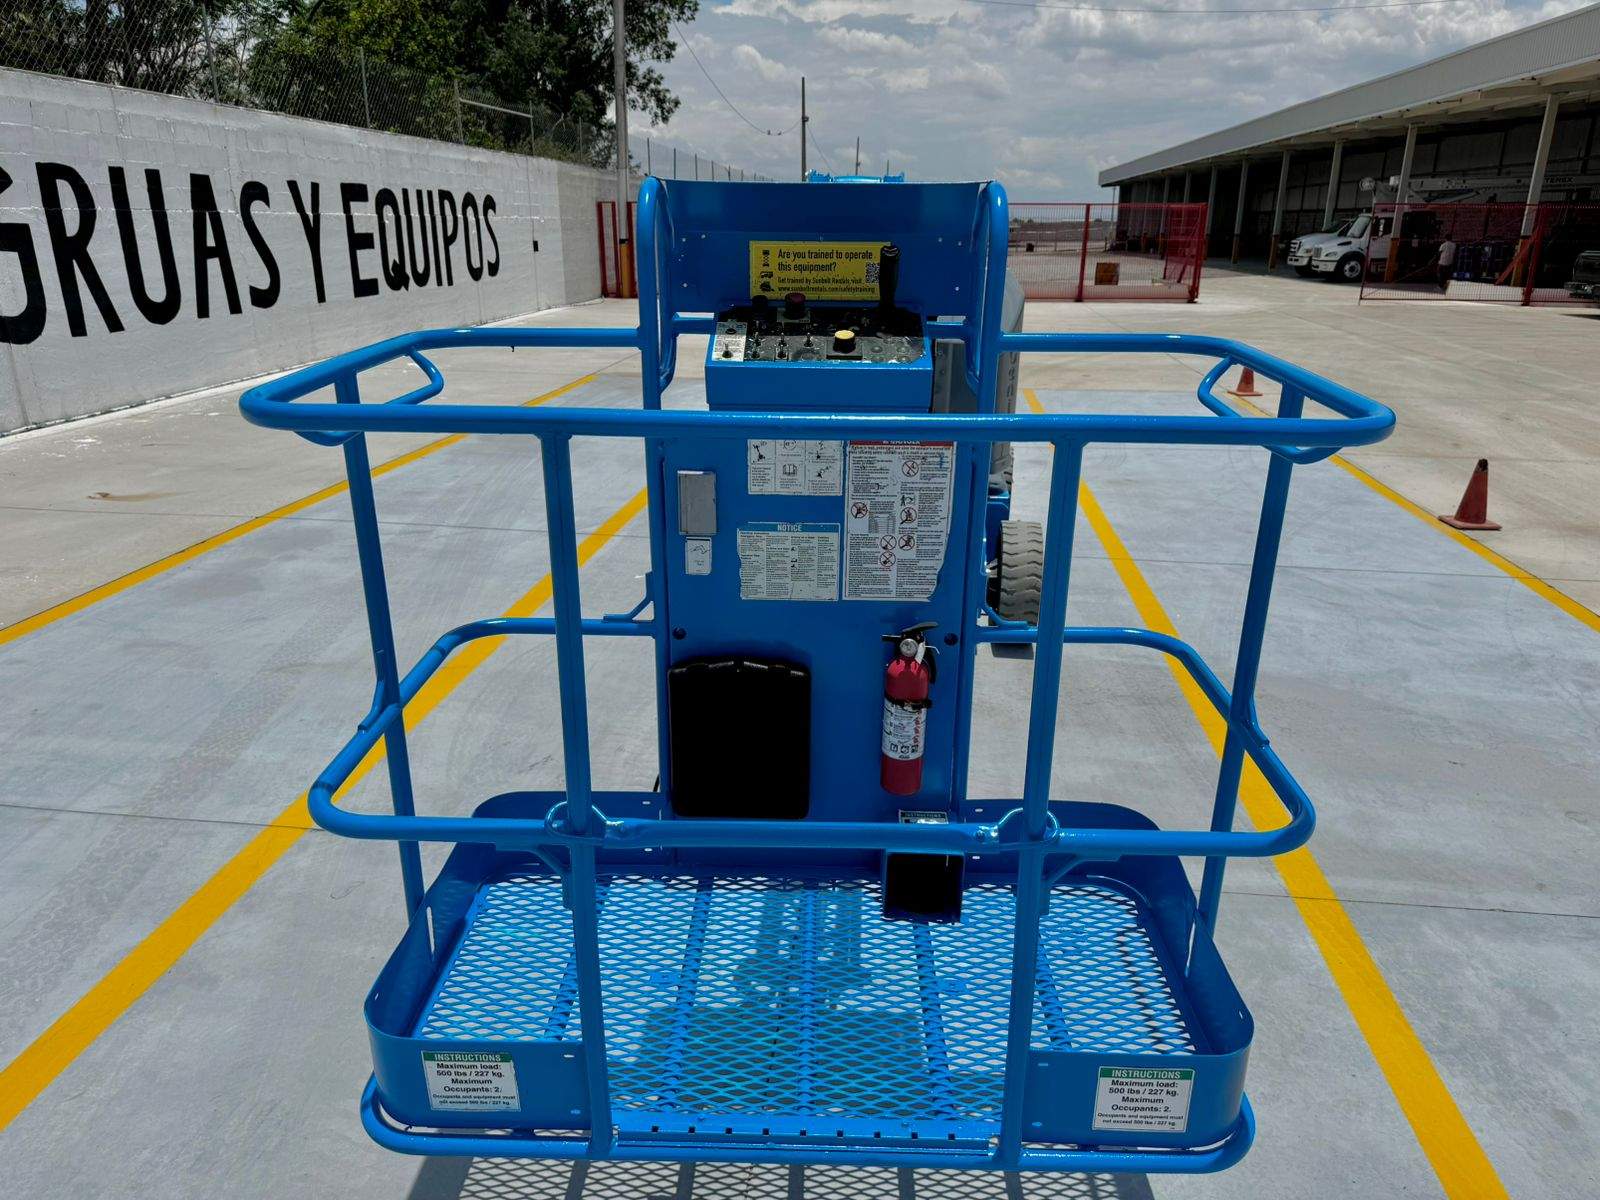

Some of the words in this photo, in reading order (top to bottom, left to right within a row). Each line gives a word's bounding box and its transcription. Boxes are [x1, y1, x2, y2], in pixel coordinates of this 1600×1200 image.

[287, 180, 326, 303] Y
[340, 183, 500, 299] EQUIPOS
[778, 249, 791, 259] Are
[791, 250, 806, 262] you
[808, 249, 834, 259] trained
[835, 250, 843, 259] to
[844, 250, 873, 262] operate
[778, 262, 792, 271] this
[793, 262, 837, 274] equipment?
[777, 524, 802, 532] NOTICE
[434, 1053, 501, 1061] INSTRUCTIONS
[436, 1062, 478, 1070] Maximum
[1111, 1069, 1181, 1079] INSTRUCTIONS
[443, 1085, 492, 1093] Occupants:
[1165, 1089, 1179, 1097] kg.
[1121, 1096, 1164, 1104] Maximum
[1111, 1104, 1162, 1113] Occupants:
